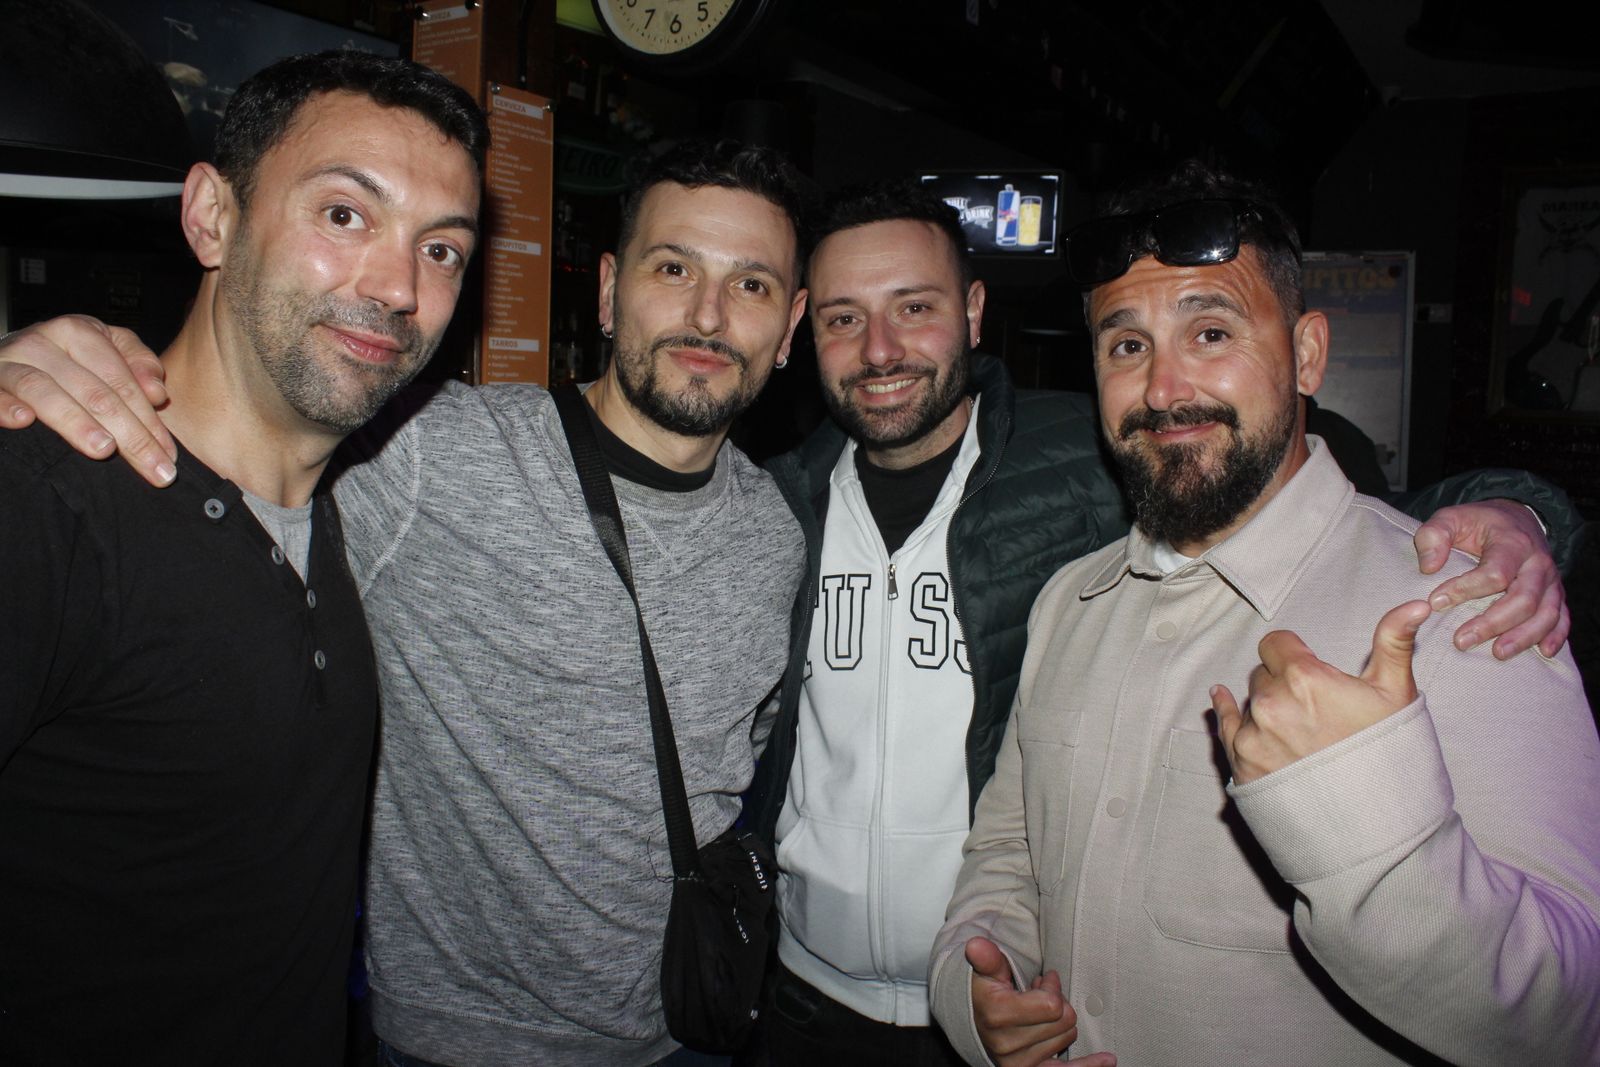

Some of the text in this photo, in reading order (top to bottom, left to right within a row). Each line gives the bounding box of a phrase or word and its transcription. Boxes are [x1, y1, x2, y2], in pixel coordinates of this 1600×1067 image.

[645, 9, 656, 29] 7
[697, 2, 708, 22] 5
[670, 15, 682, 34] 6
[495, 99, 526, 113] CERVEZA
[966, 209, 990, 221] DRINK
